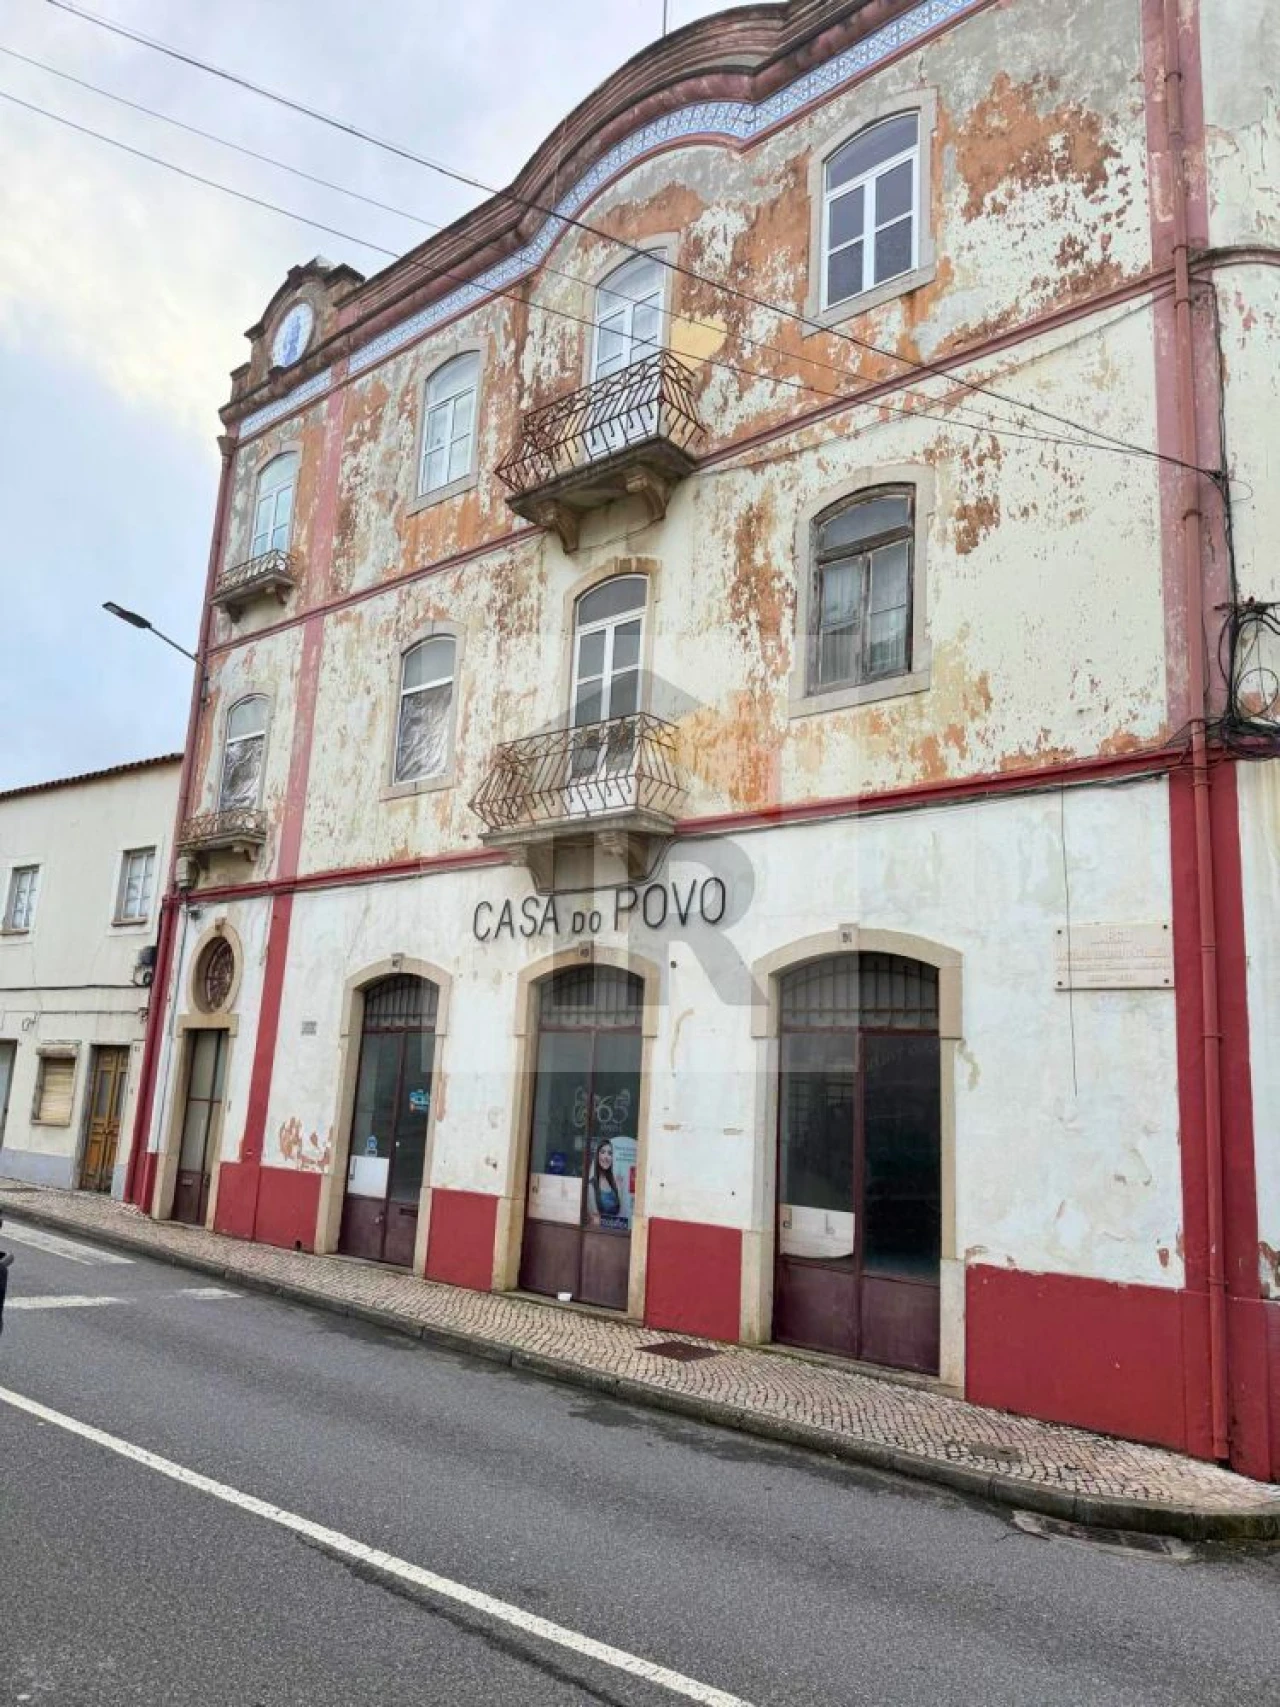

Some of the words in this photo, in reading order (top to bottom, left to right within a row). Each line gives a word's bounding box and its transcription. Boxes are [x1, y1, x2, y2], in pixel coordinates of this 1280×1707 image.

[472, 894, 560, 942] CASA
[571, 910, 602, 934] DO
[614, 875, 727, 932] POVO
